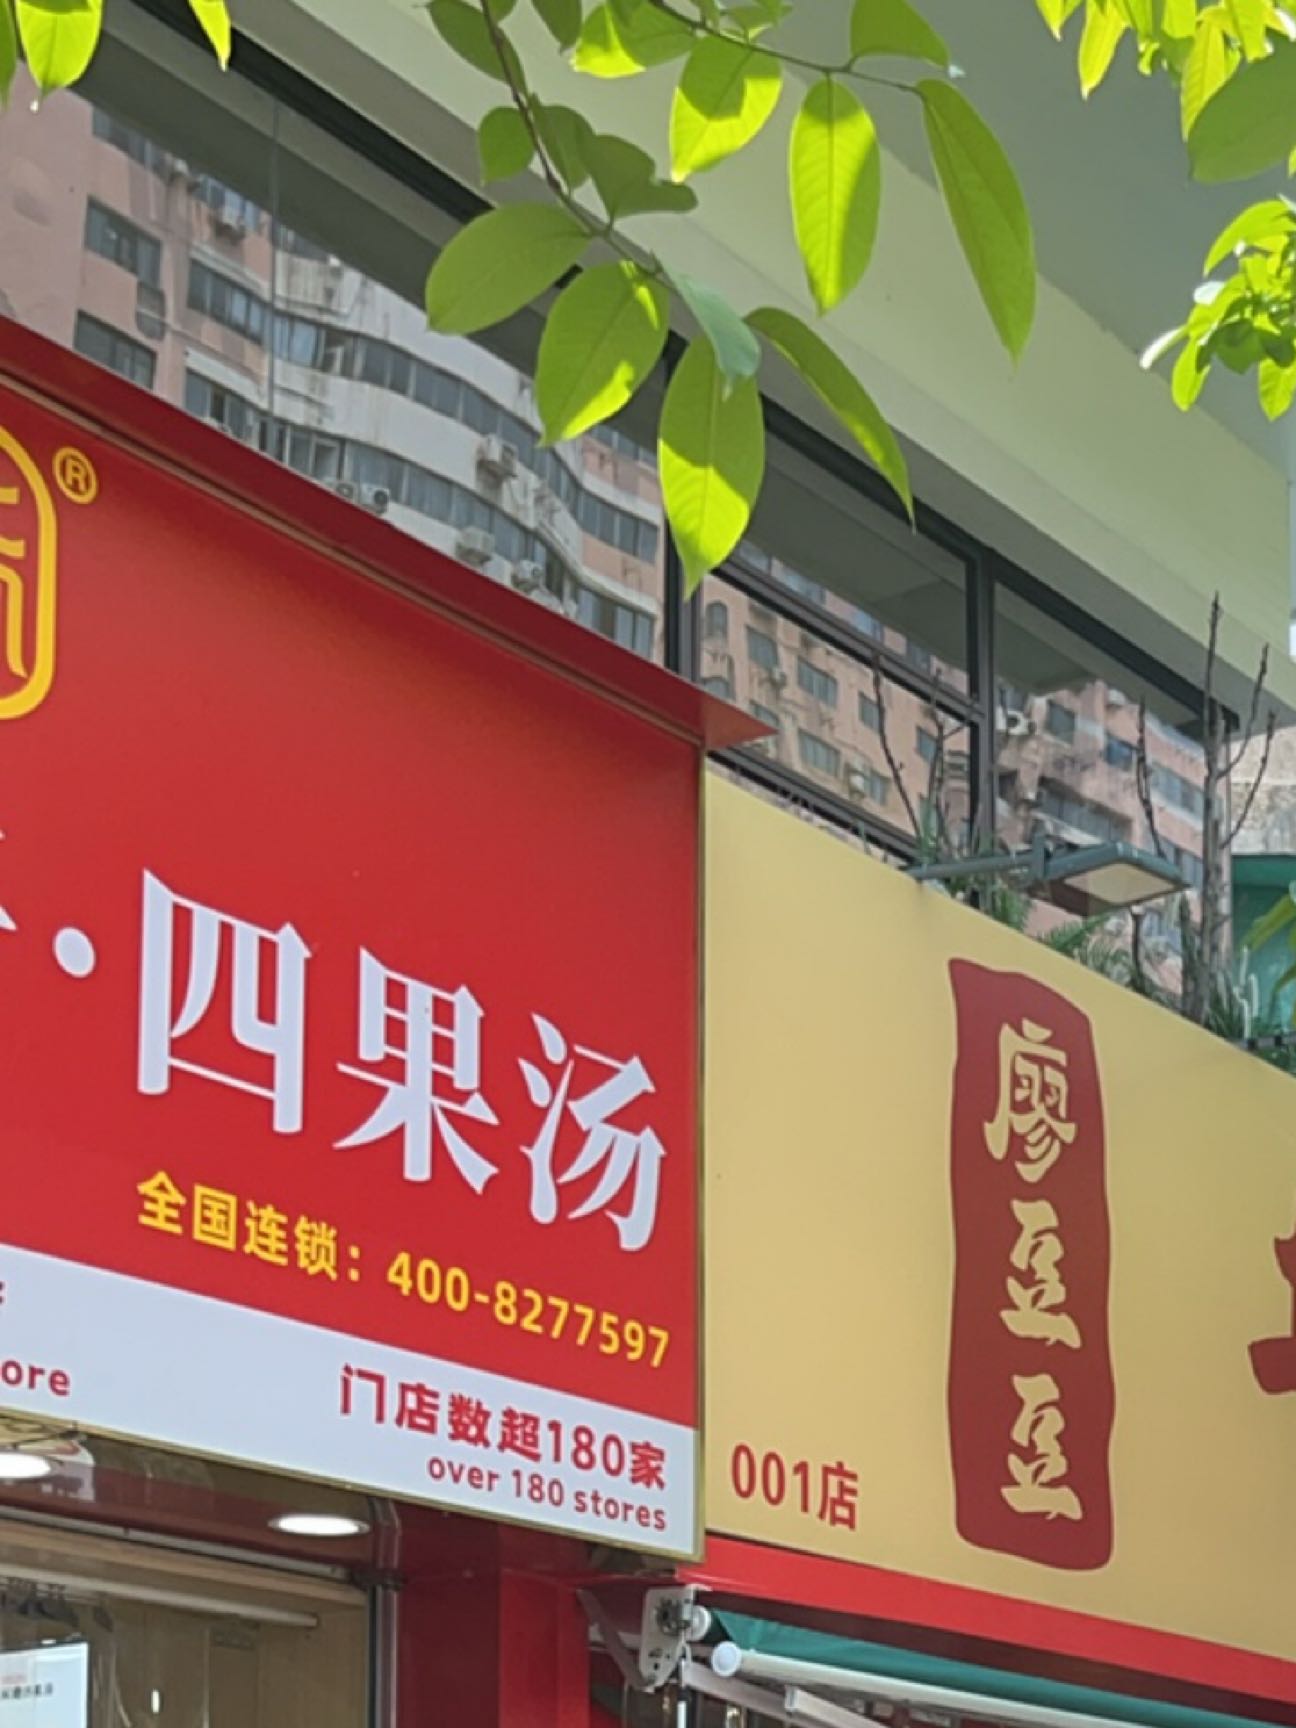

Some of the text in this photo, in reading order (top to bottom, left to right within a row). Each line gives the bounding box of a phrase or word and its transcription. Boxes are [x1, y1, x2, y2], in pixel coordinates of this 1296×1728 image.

[983, 1018, 1082, 1520] 廖豆豆
[340, 1362, 666, 1490] 门店数超180家
[427, 1456, 666, 1531] over 180 stores
[730, 1443, 860, 1531] 001店
